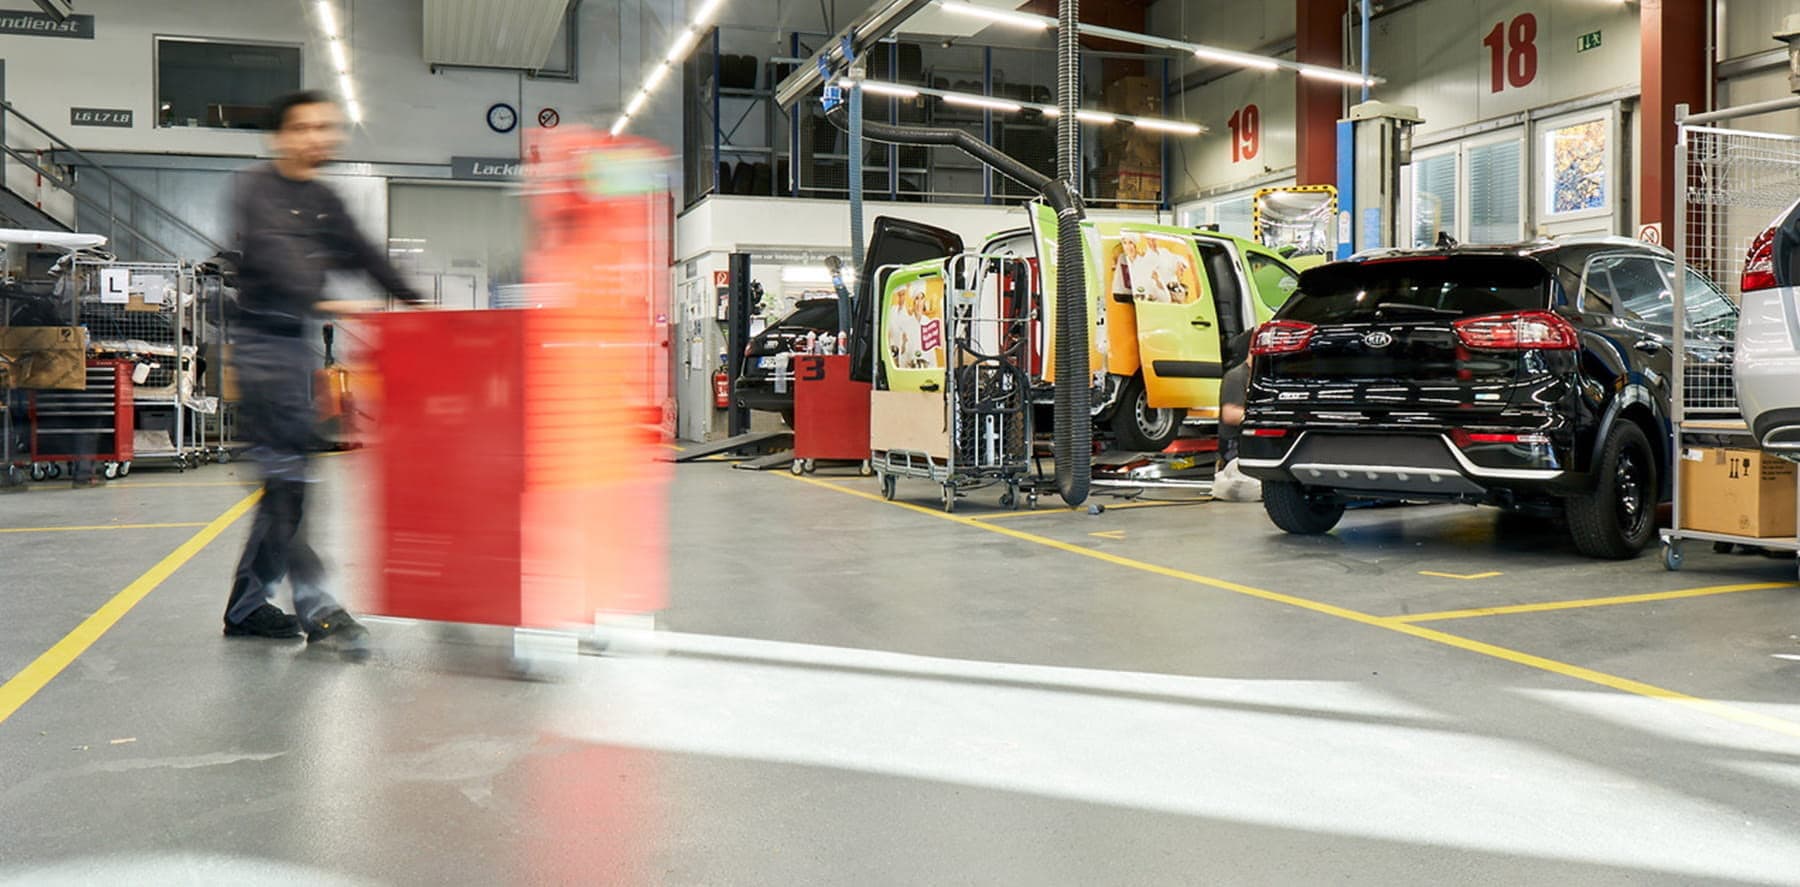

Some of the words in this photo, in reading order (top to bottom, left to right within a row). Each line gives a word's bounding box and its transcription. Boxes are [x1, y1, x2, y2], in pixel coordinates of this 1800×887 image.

[0, 15, 79, 32] ndienst
[1483, 12, 1538, 93] 18
[94, 113, 111, 121] L7
[1228, 104, 1259, 163] 19
[109, 276, 123, 293] L
[801, 356, 825, 381] 3
